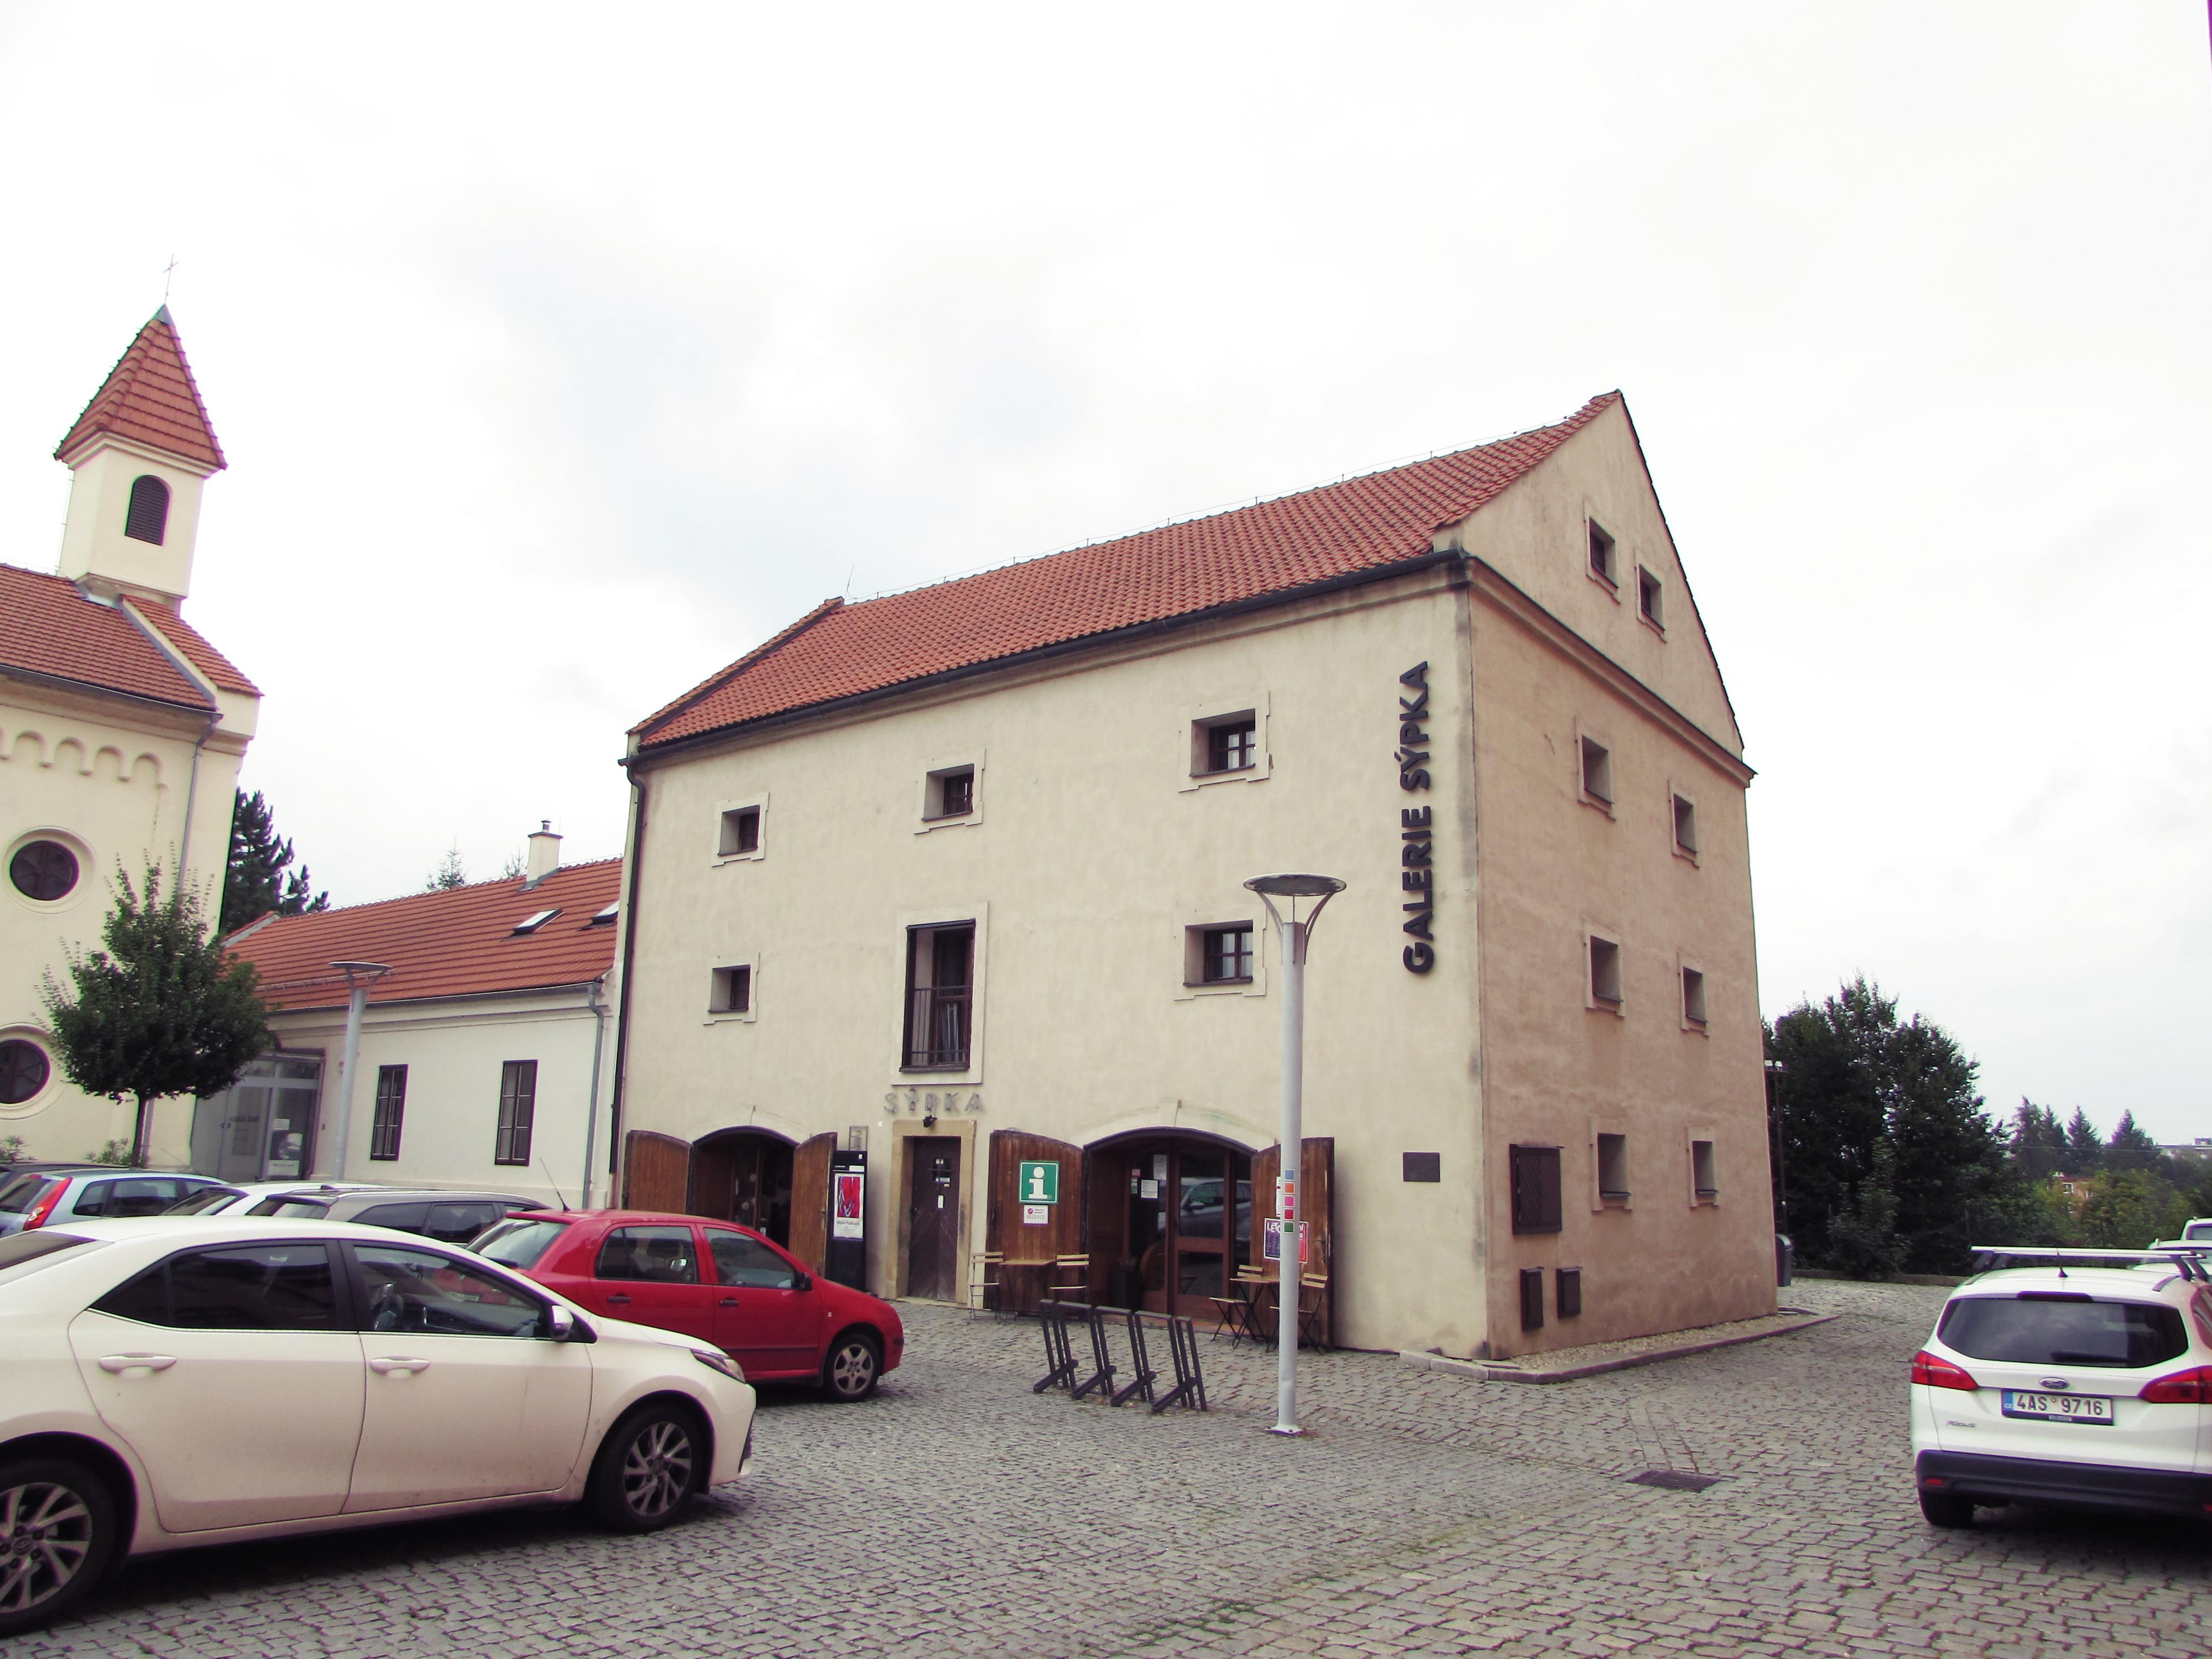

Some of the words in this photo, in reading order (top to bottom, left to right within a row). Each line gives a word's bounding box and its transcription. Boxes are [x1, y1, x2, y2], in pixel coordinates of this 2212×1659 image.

[1394, 660, 1429, 791] SÝPKA
[1402, 805, 1434, 974] GALERIE
[884, 1087, 984, 1114] SÝPKA
[2017, 1394, 2047, 1411] 4AS
[2060, 1398, 2103, 1416] 9716
